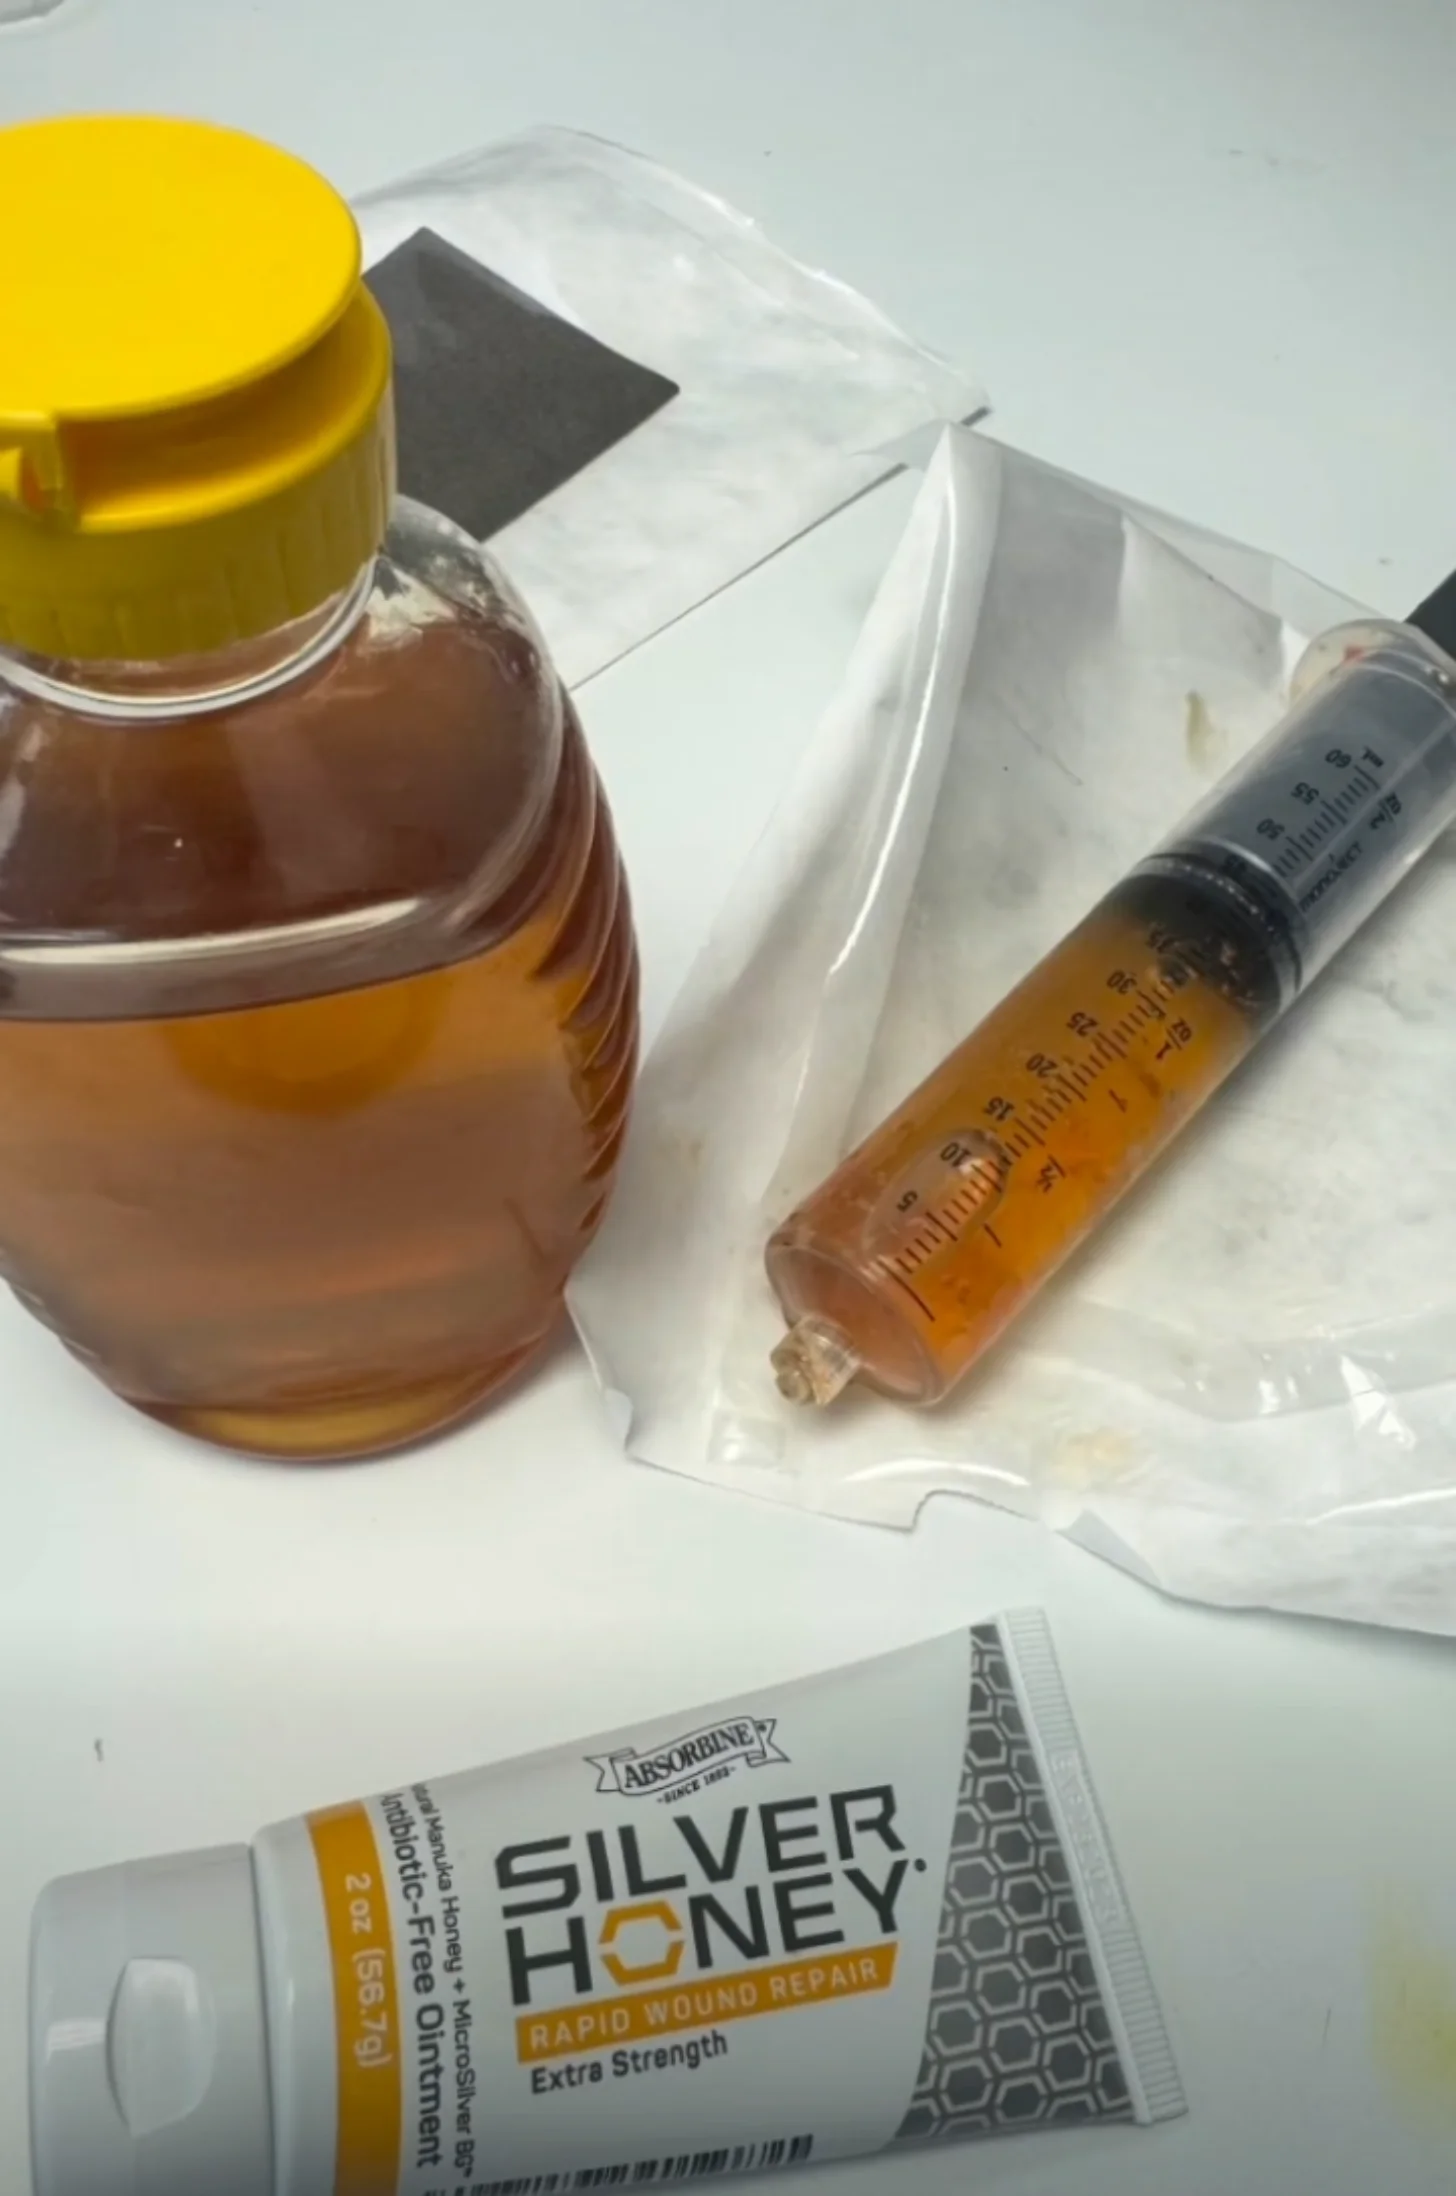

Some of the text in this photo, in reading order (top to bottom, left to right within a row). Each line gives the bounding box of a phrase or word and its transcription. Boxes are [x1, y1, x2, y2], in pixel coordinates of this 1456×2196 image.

[1325, 748, 1351, 769] 60
[1291, 781, 1320, 805] 55
[1256, 817, 1285, 841] 50
[1107, 969, 1138, 995] 30
[1066, 1011, 1099, 1037] 25
[1025, 1052, 1059, 1079] 20
[982, 1096, 1016, 1122] 15
[940, 1142, 973, 1168] 10
[896, 1190, 919, 1213] 5
[624, 1722, 755, 1789] ABSORBINE
[424, 1815, 454, 1892] Manuka
[495, 1784, 906, 1920] SILVER
[440, 1896, 464, 1975] Honey
[505, 1858, 909, 2006] HONEY
[345, 1872, 394, 2068] 2 oz (56.7g)
[453, 1978, 467, 1993] +
[530, 1957, 881, 2051] RAPID WOUND REPAIR
[452, 1998, 476, 2136] MicroSilver
[530, 2031, 729, 2095] Extra Strength
[415, 2003, 447, 2169] Ointment
